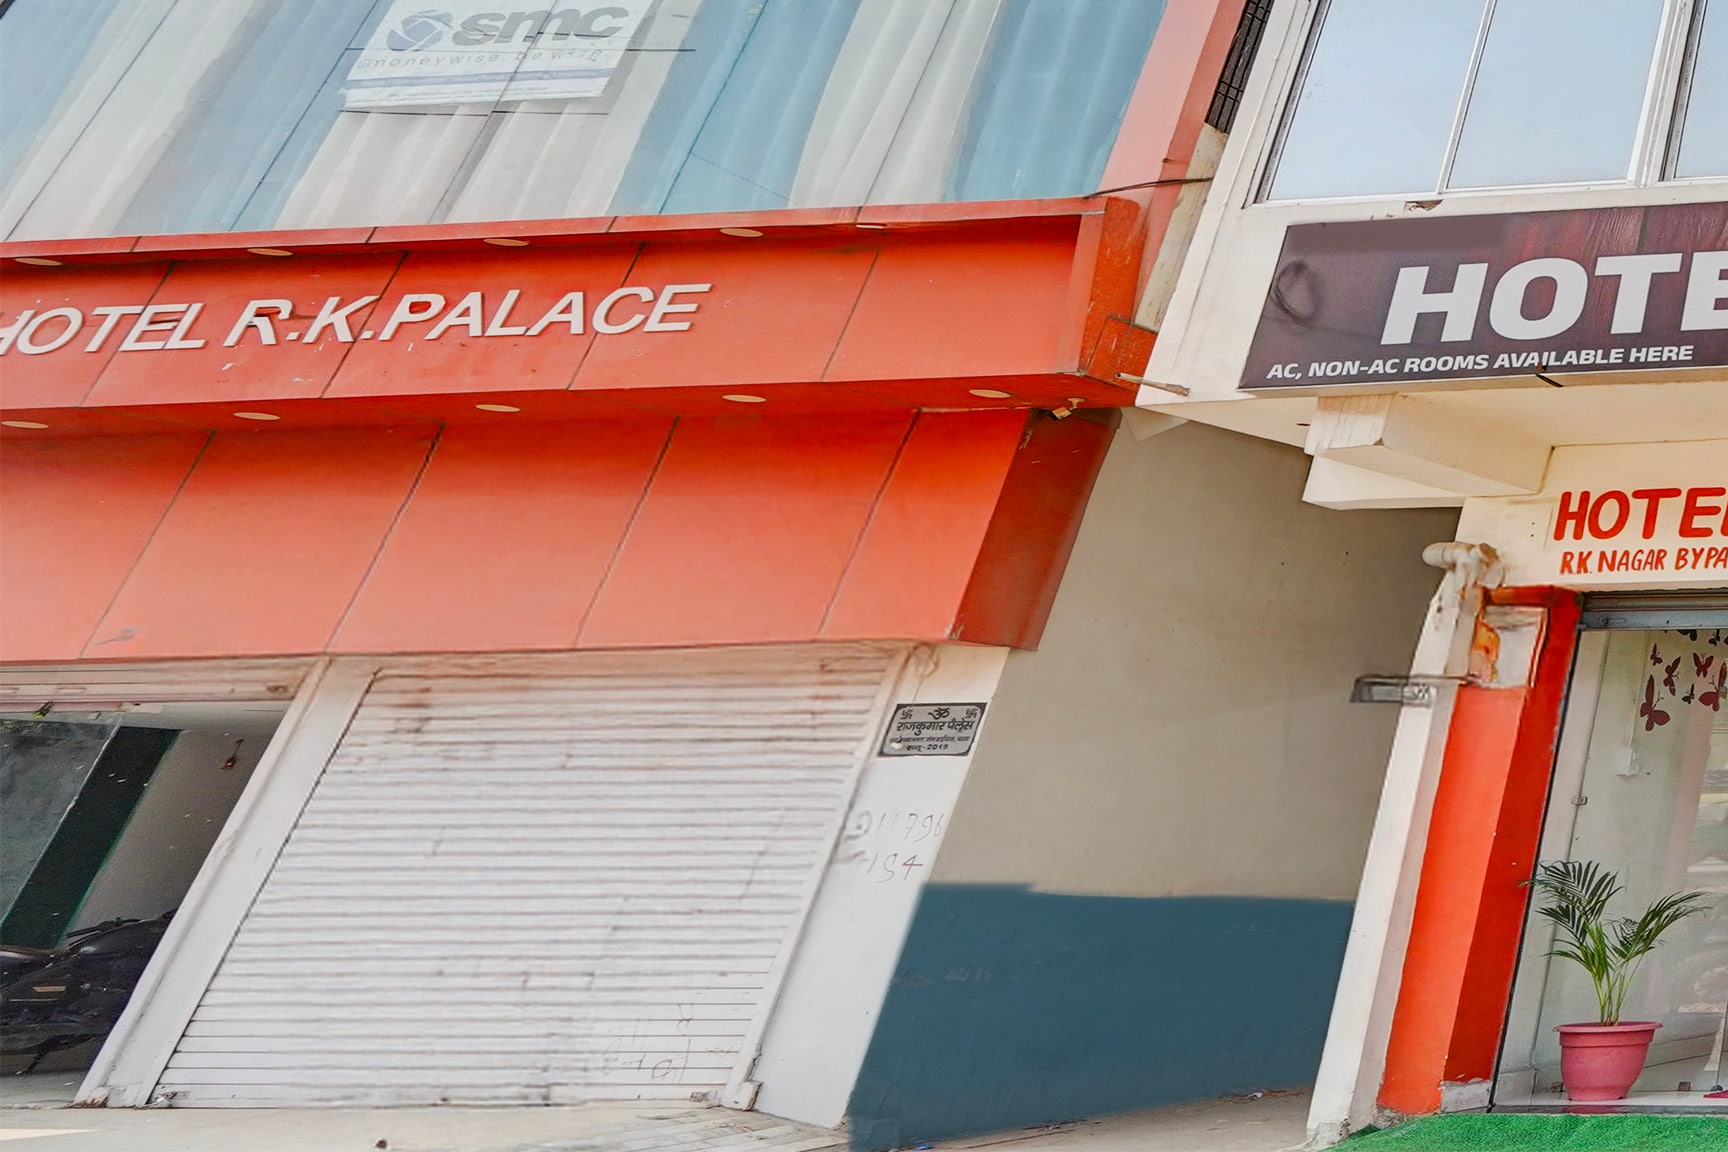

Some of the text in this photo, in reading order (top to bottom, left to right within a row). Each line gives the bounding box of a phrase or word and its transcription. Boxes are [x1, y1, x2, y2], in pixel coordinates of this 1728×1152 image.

[379, 283, 712, 342] PALACE
[1266, 345, 1694, 380] AC, NON-AC ROOMS AVAILABLE HERE
[1597, 548, 1667, 573] NAGAR
